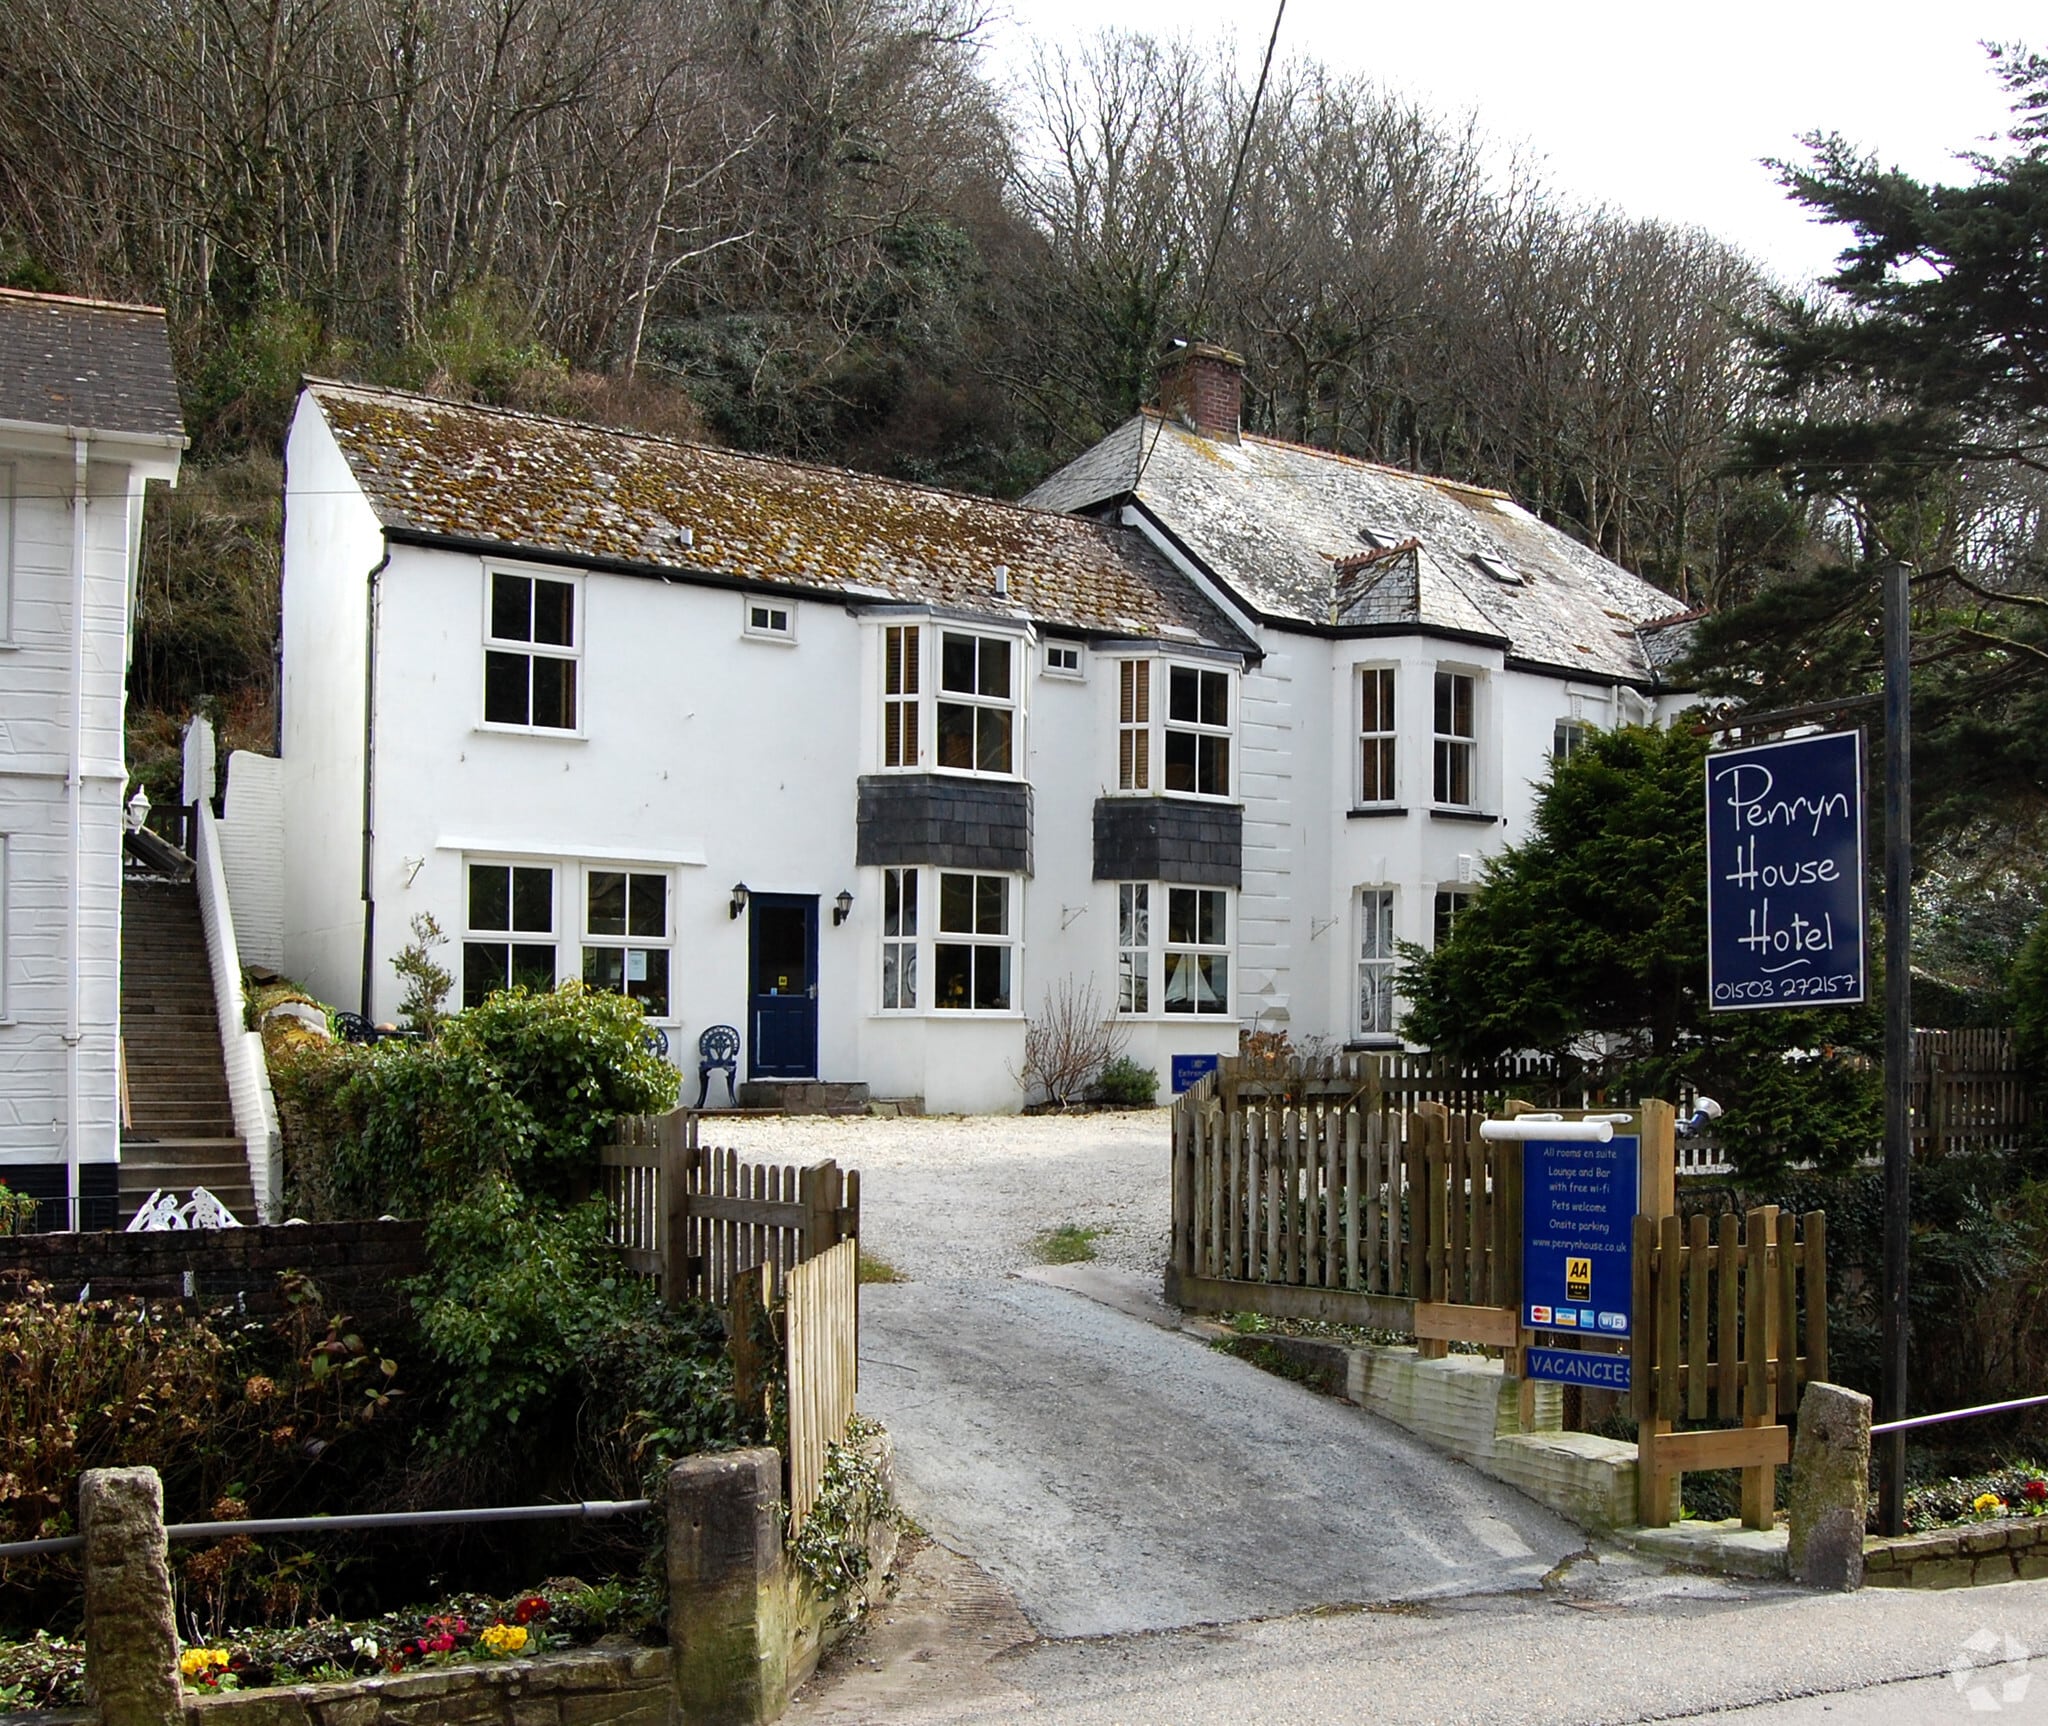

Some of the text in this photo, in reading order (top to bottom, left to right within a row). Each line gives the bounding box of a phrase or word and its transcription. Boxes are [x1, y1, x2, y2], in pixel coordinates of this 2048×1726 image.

[1715, 764, 1849, 837] Penryn
[1726, 834, 1840, 891] House
[1738, 897, 1833, 955] Hotel
[1714, 975, 1856, 999] 01503 272157
[1543, 1147, 1617, 1159] All rooms en suite
[1548, 1166, 1611, 1179] Lounge and Bar
[1549, 1181, 1567, 1191] with
[1569, 1182, 1588, 1193] free
[1552, 1200, 1607, 1213] Pets welcome
[1549, 1219, 1610, 1235] Onsite parking
[1532, 1239, 1627, 1252] www.penrynhouse.co.uk
[1570, 1262, 1588, 1279] AA
